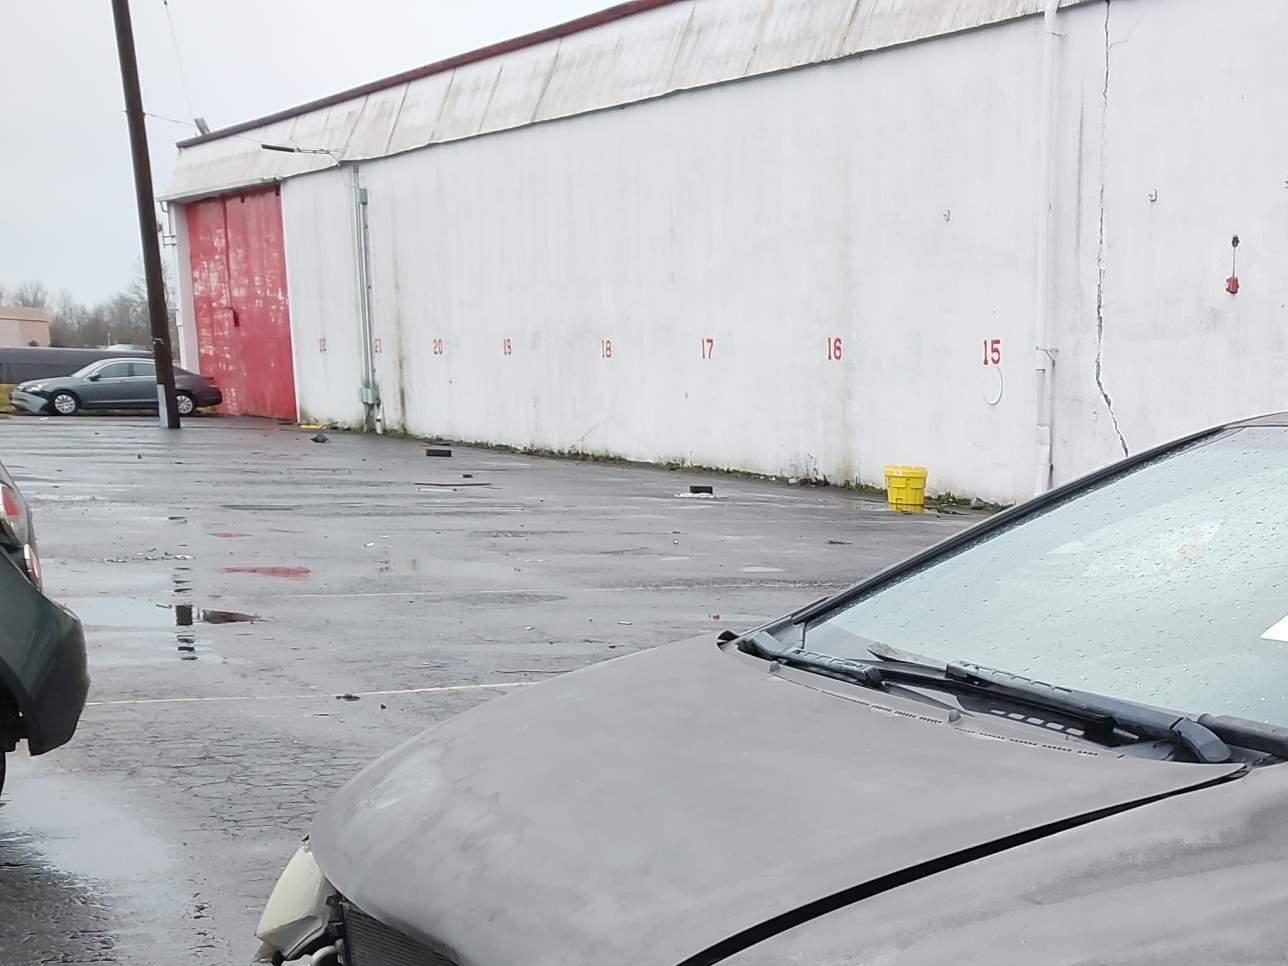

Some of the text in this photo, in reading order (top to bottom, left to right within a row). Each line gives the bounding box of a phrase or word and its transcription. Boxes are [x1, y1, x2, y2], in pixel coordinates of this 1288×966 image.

[432, 337, 443, 355] 20
[502, 338, 513, 356] 19
[601, 338, 612, 359] 18
[700, 337, 714, 360] 17
[827, 336, 842, 361] 16
[982, 338, 1001, 366] 15
